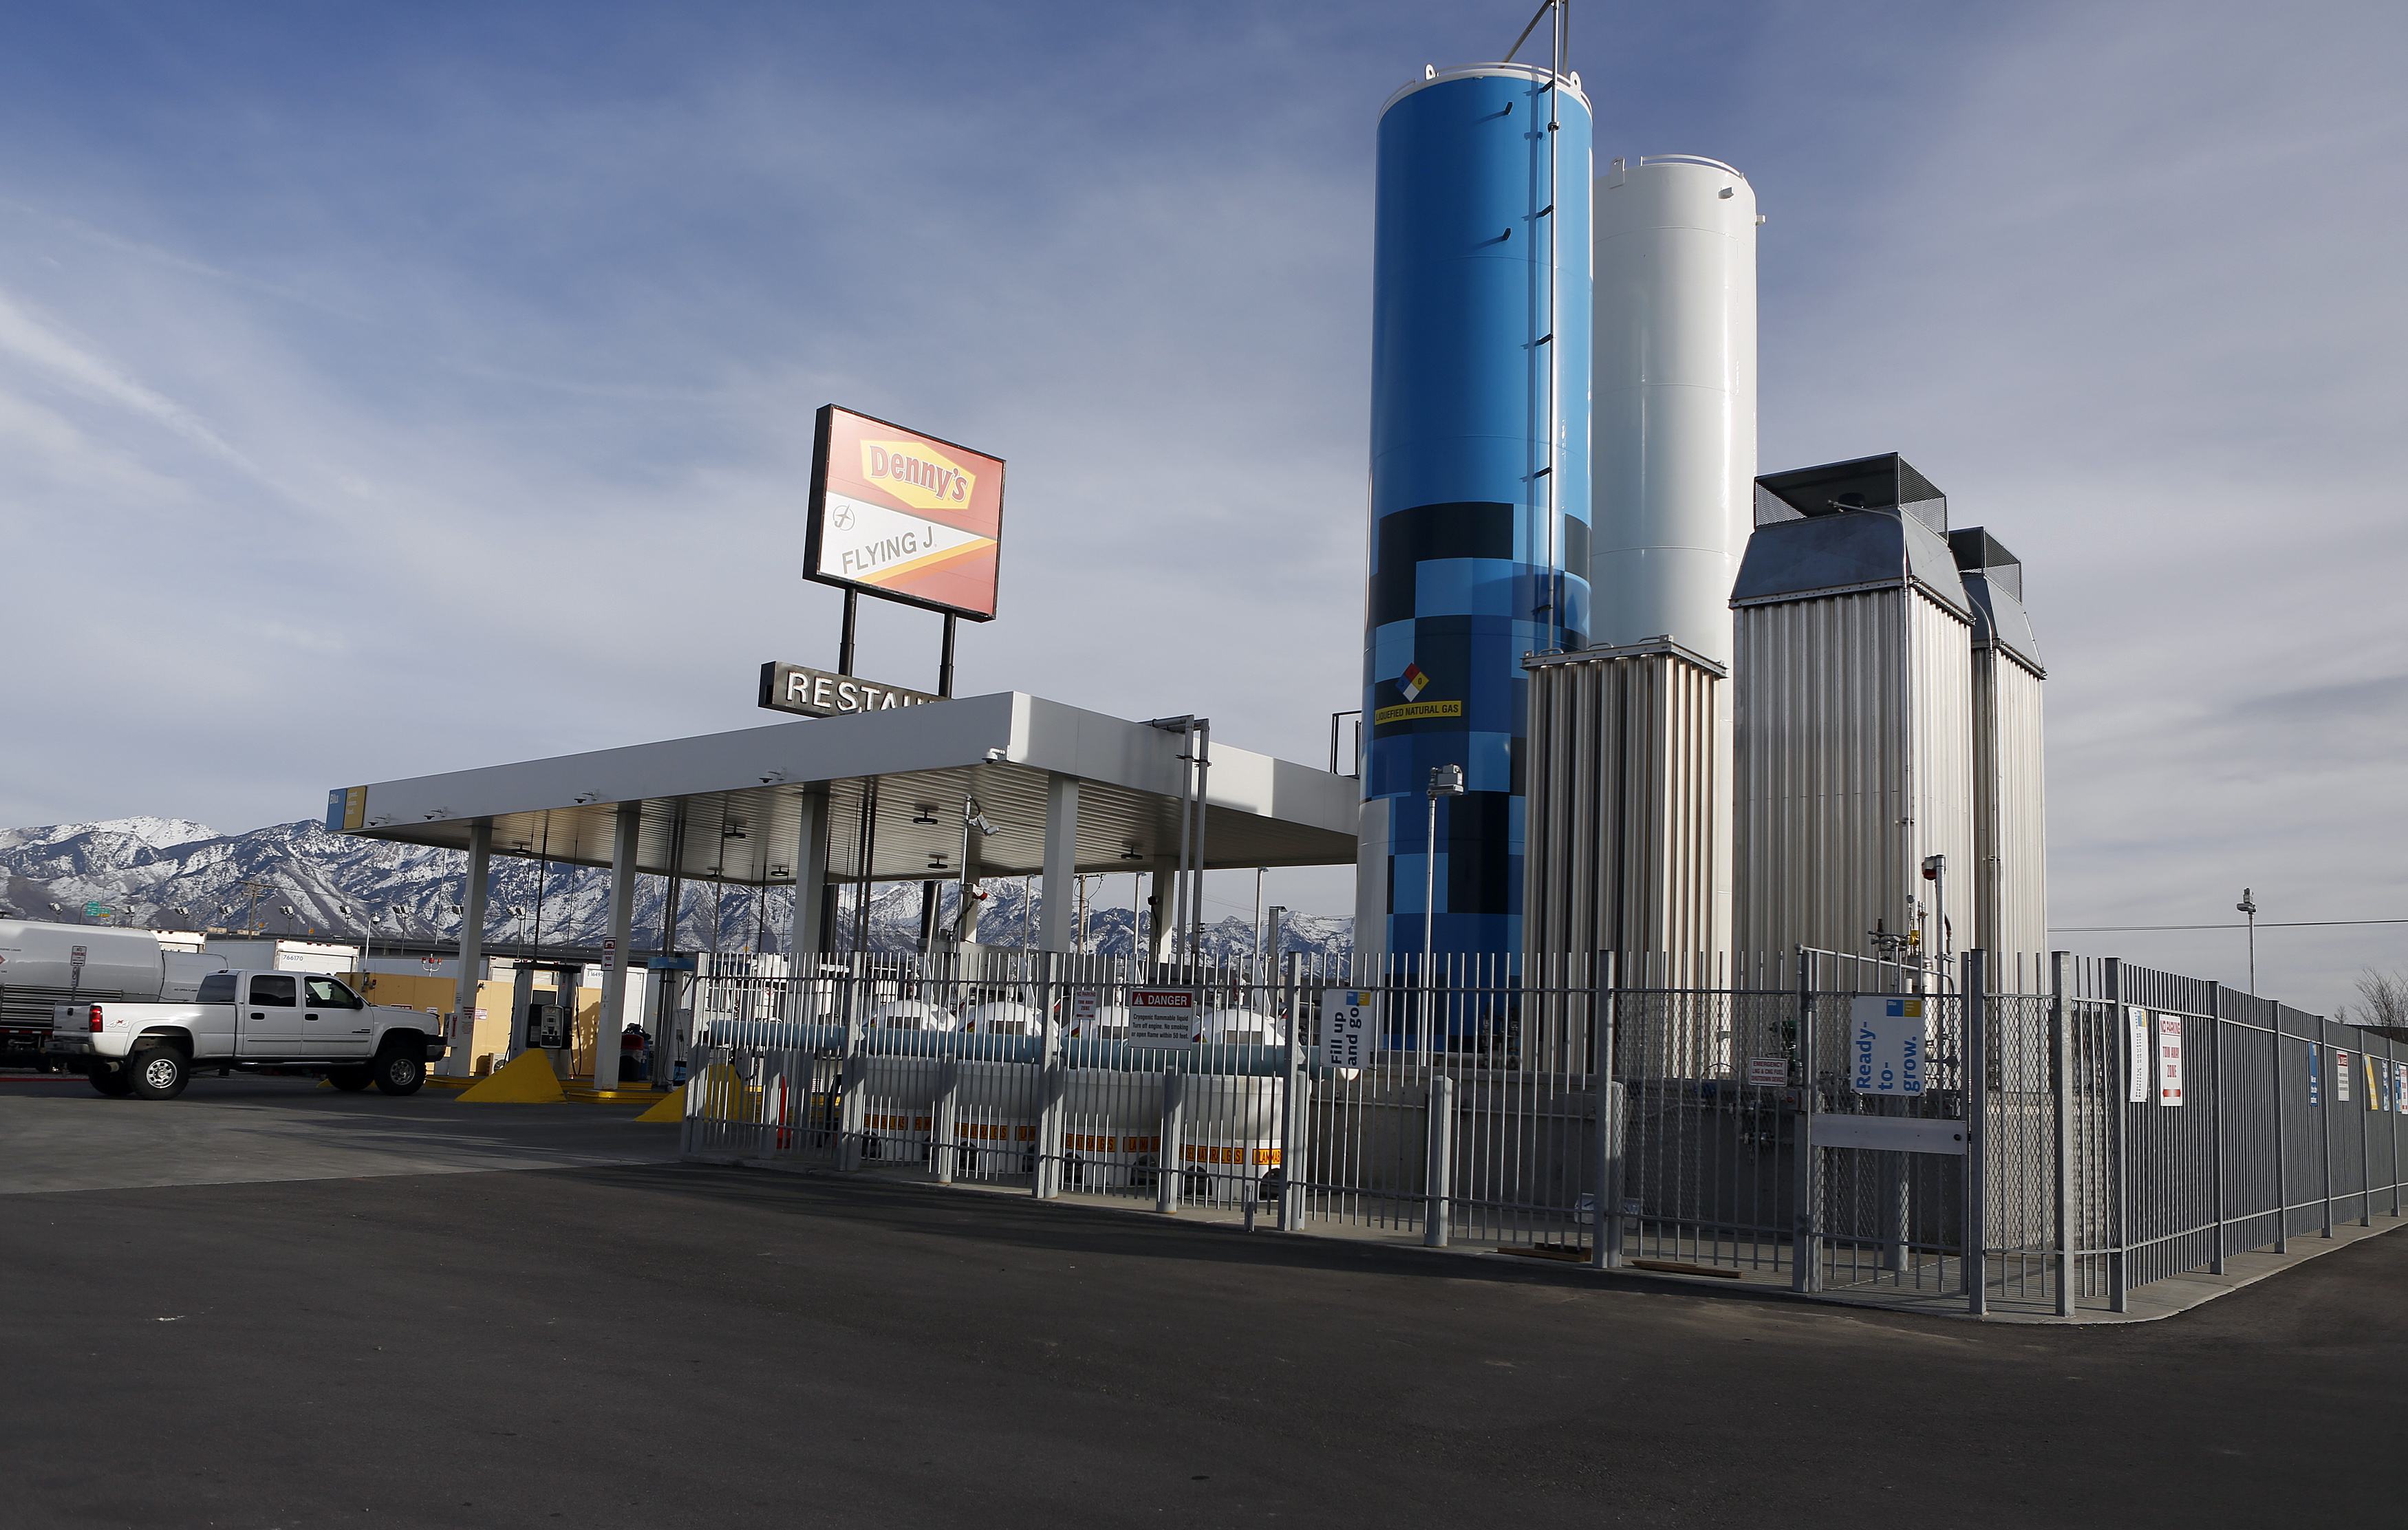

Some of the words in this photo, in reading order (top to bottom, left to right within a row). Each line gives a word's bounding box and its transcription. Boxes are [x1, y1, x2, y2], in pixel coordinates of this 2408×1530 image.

[869, 445, 969, 503] Denny's
[841, 532, 917, 575] FLYING
[923, 526, 934, 549] J
[786, 671, 934, 714] RESTA
[1375, 708, 1404, 722] LIQUEFIED
[1405, 704, 1439, 716] NATURAL
[1441, 704, 1459, 713] GAS
[1148, 995, 1187, 1006] DANGER
[1154, 1013, 1176, 1021] flammable
[1334, 1012, 1346, 1033] up
[2160, 1020, 2166, 1033] NO
[2167, 1020, 2180, 1035] PARKING
[1330, 1039, 1342, 1064] Fill
[1346, 1034, 1358, 1066] and
[1856, 1021, 1876, 1088] Ready-
[2162, 1046, 2171, 1058] TOW
[2171, 1046, 2180, 1059] AWAY
[1878, 1062, 1893, 1090] to-
[1903, 1036, 1921, 1092] grow.
[2167, 1064, 2177, 1078] ZONE
